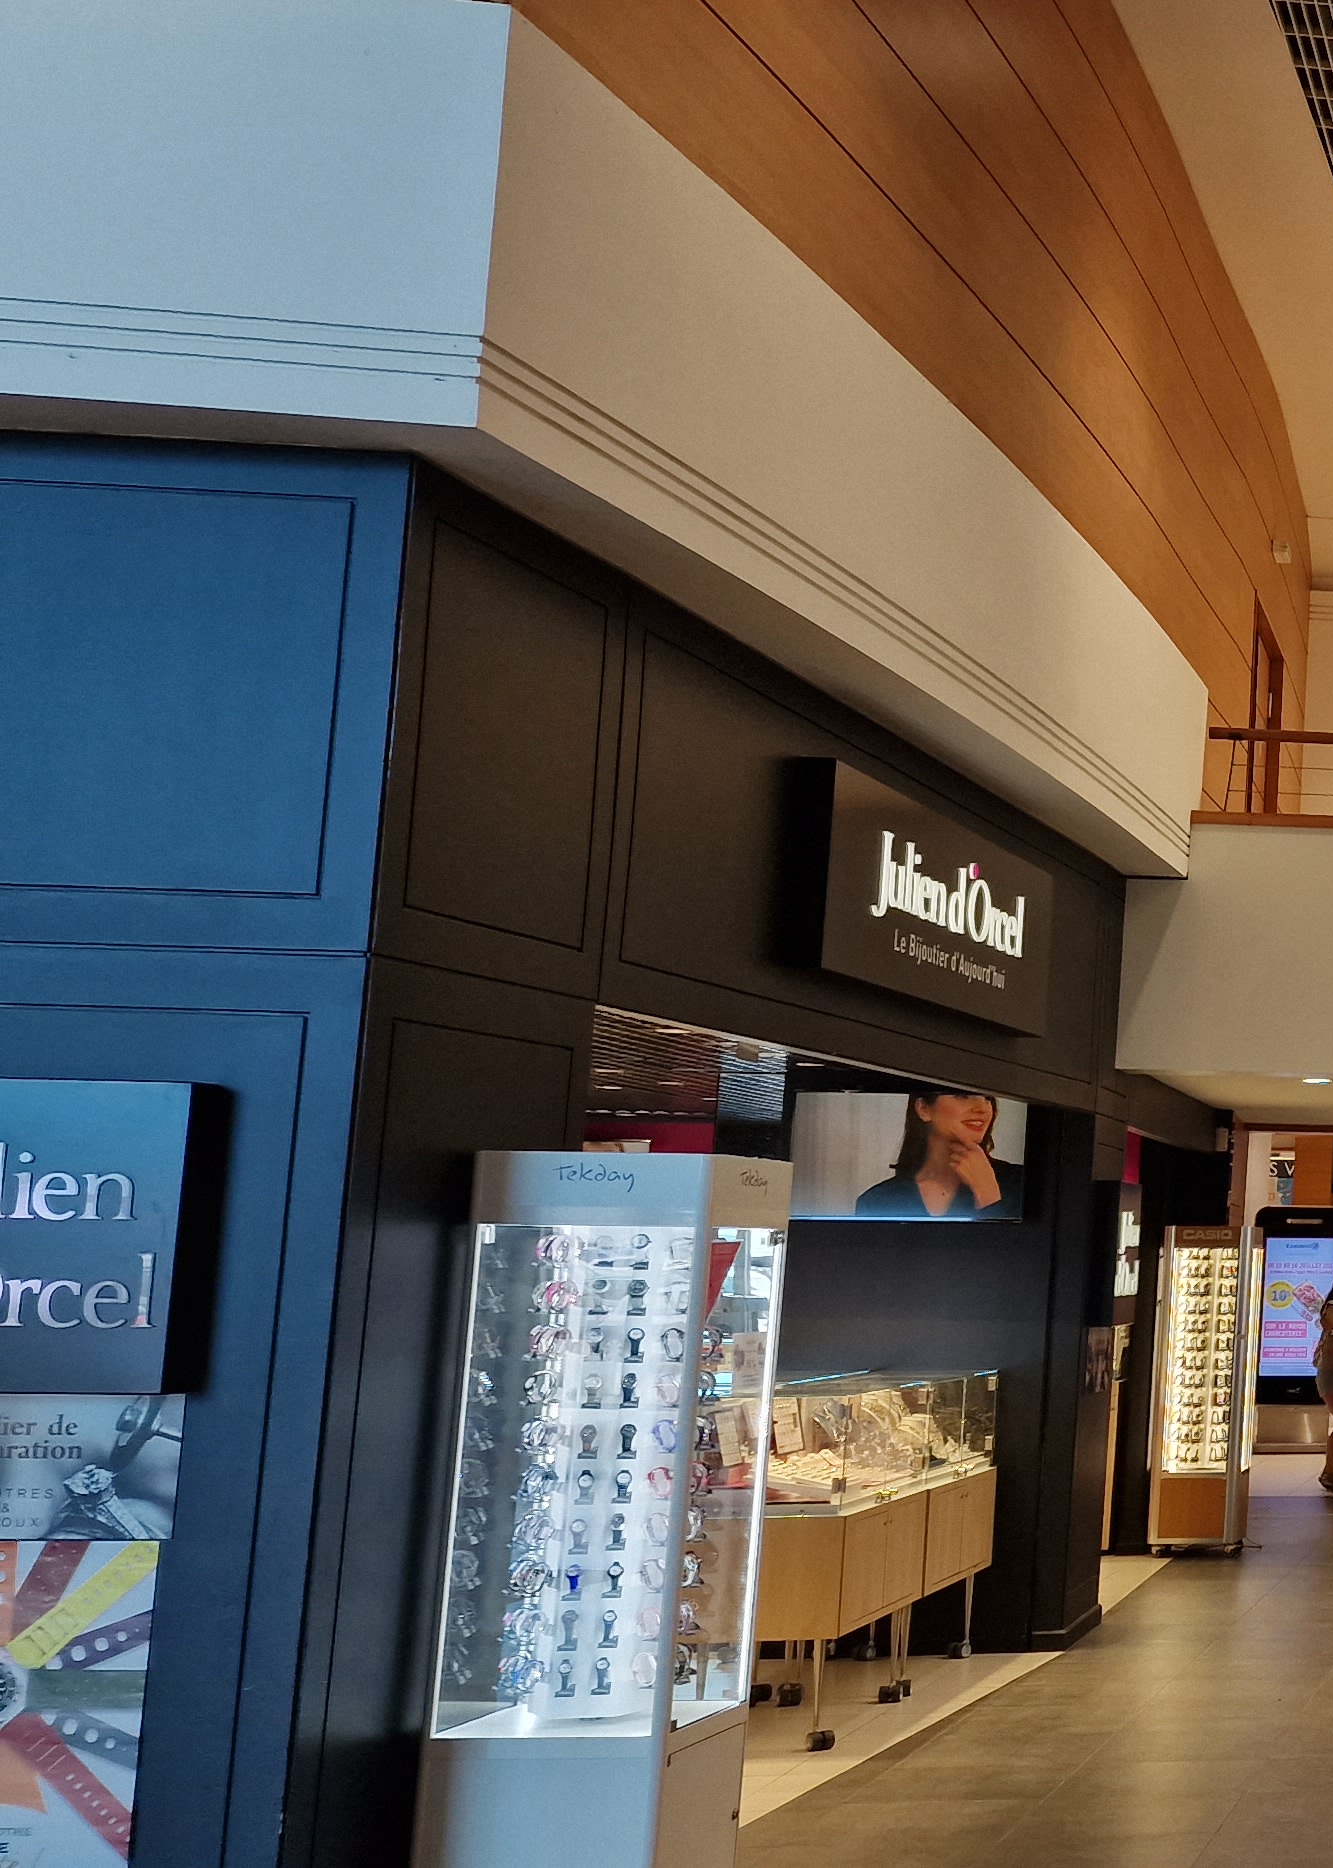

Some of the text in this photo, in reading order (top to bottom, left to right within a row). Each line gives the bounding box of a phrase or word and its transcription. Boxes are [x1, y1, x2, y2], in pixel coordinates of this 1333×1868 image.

[870, 830, 1026, 959] Julien d'Orcel
[893, 928, 1006, 990] Le Bijoutier d'Aujourd'hui
[552, 1162, 635, 1192] Tekday
[1182, 1229, 1233, 1241] CASIO
[0, 1251, 157, 1329] rcel
[48, 1413, 79, 1436] de
[0, 1440, 82, 1459] ration
[0, 1488, 54, 1499] TRES
